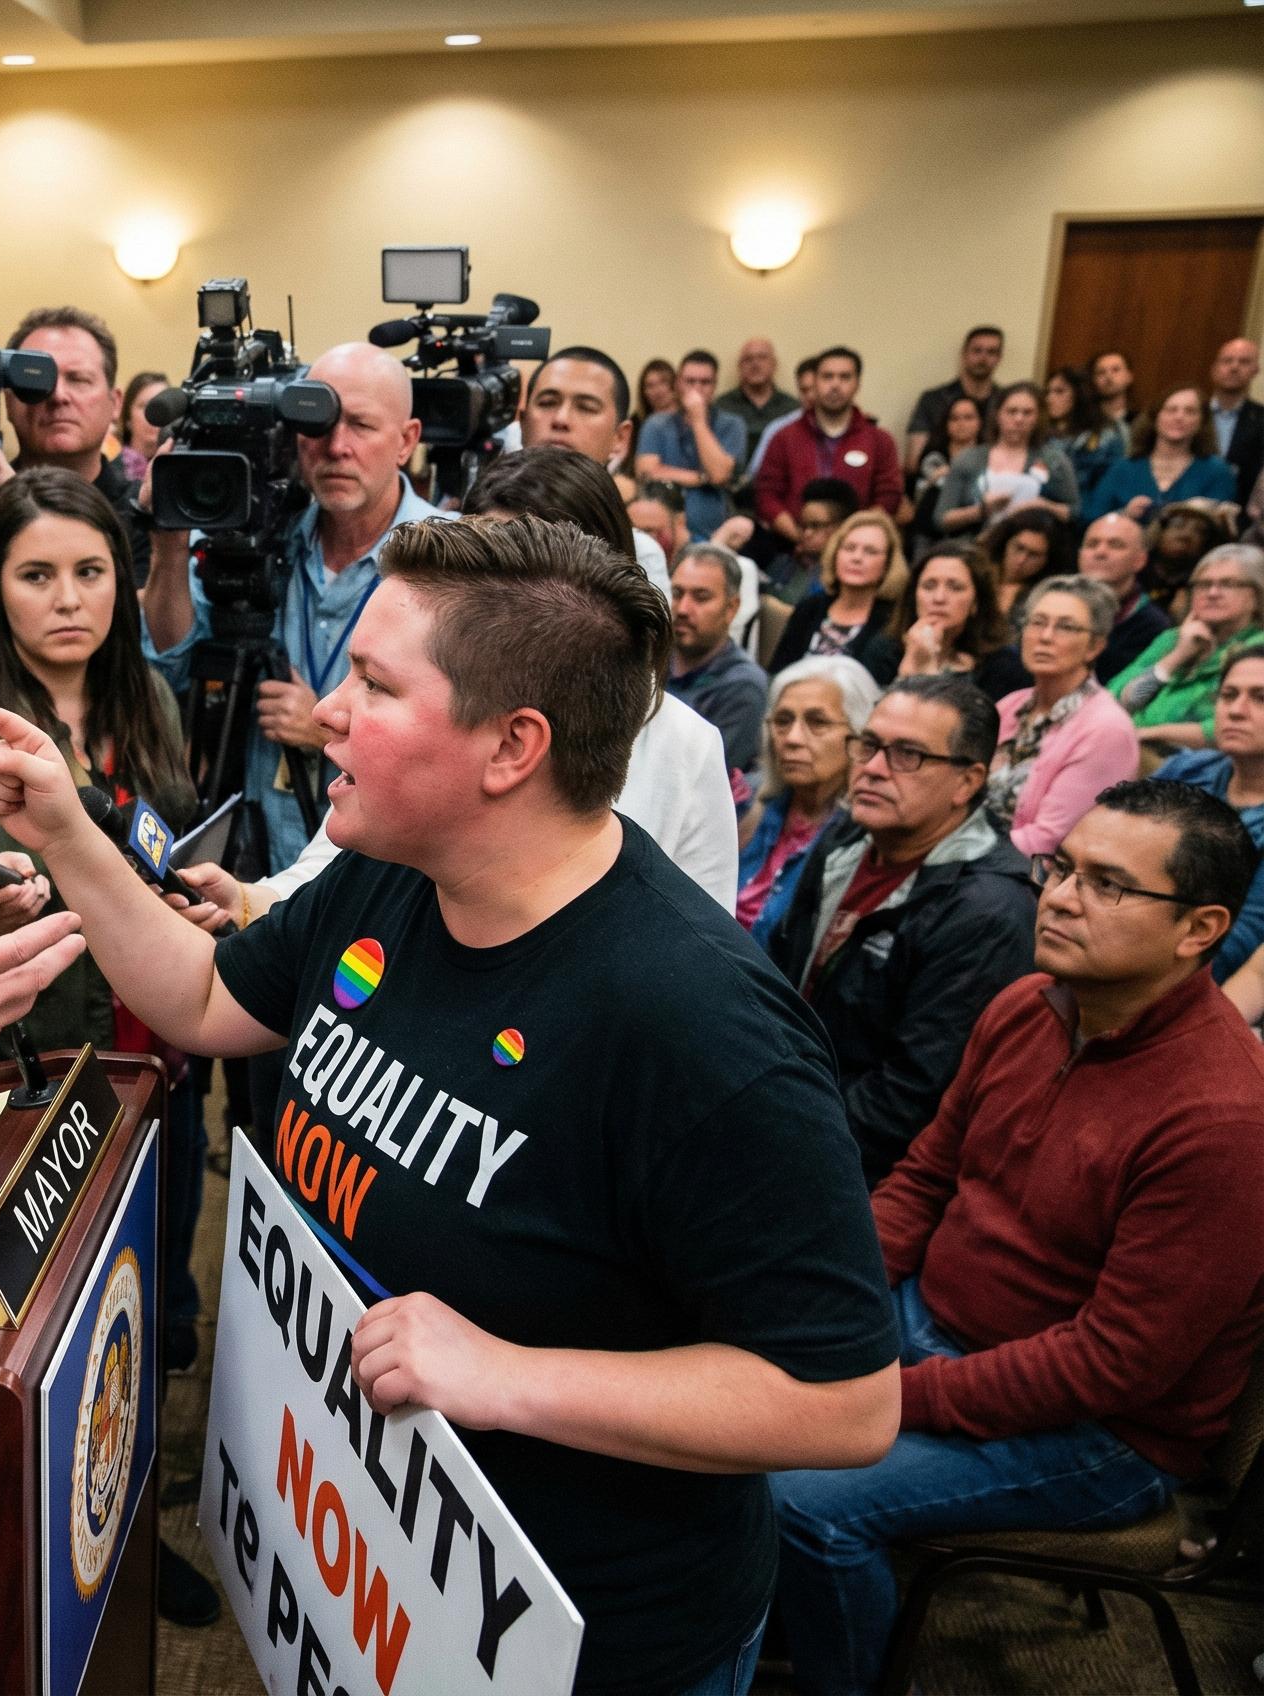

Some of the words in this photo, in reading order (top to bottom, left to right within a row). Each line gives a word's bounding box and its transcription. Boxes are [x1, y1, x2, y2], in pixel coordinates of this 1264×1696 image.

[12, 1100, 99, 1254] MAYOR
[274, 1100, 378, 1241] NOW
[287, 1003, 529, 1209] EQUALITY
[238, 1175, 533, 1681] EQUALITY
[267, 1551, 351, 1696] PE
[276, 1403, 412, 1696] NOW
